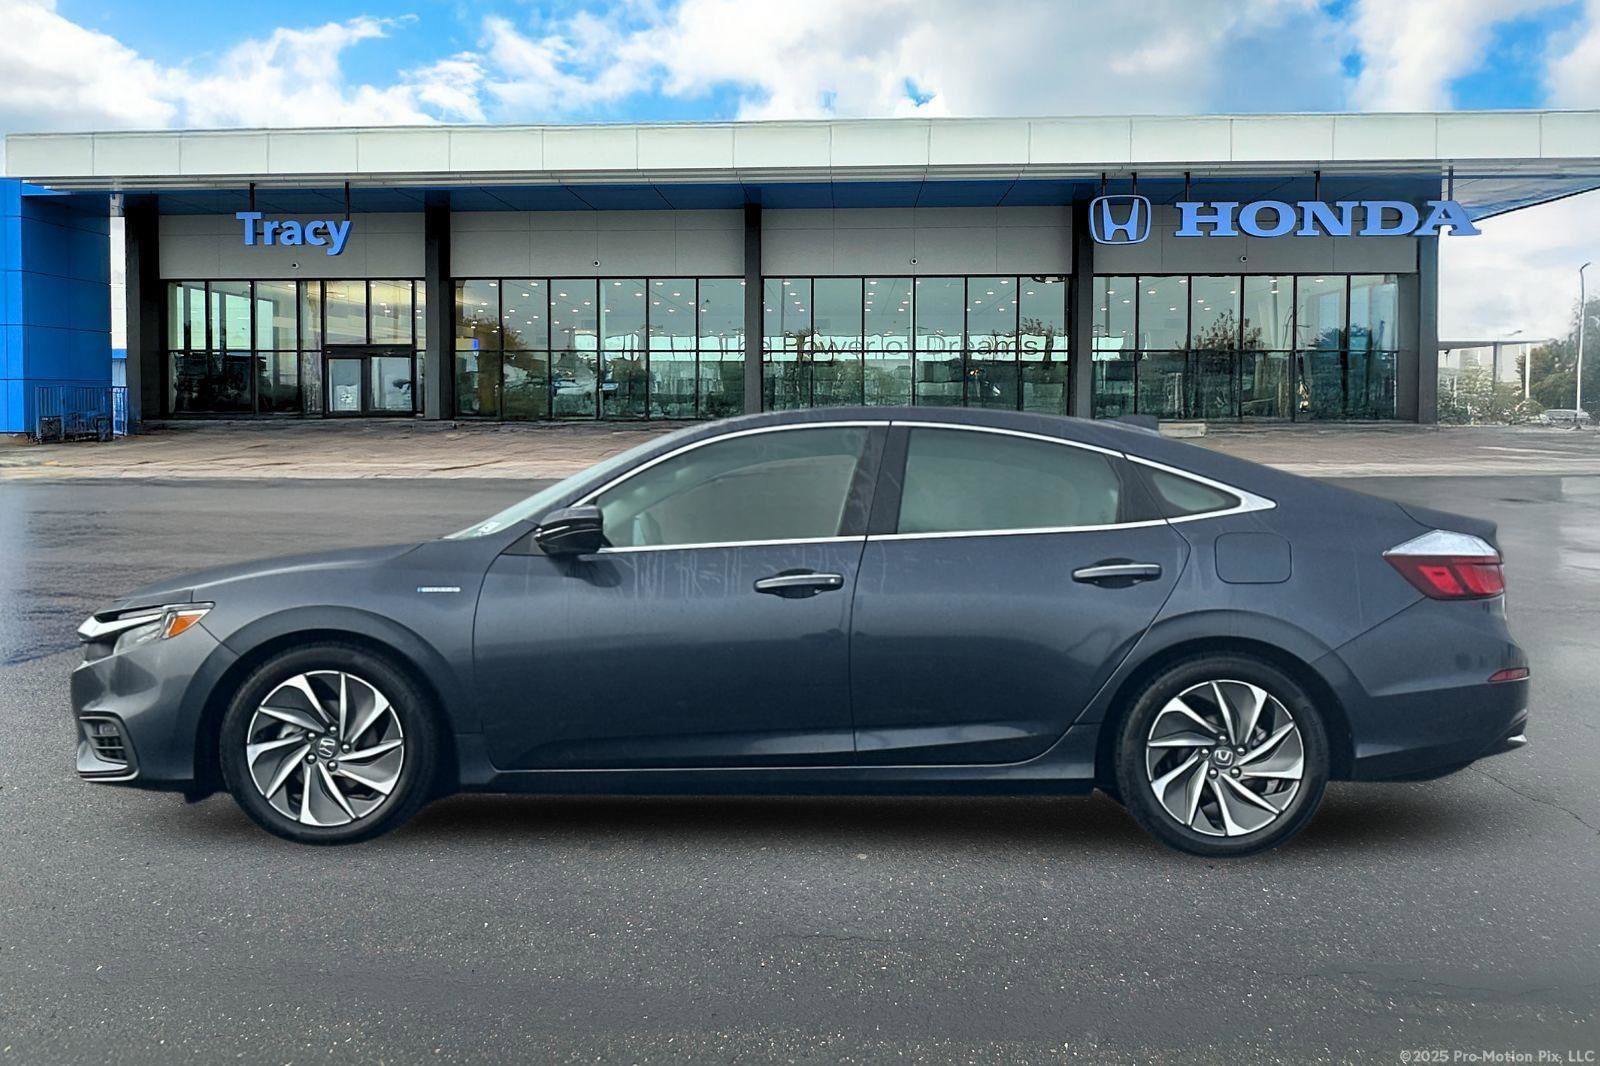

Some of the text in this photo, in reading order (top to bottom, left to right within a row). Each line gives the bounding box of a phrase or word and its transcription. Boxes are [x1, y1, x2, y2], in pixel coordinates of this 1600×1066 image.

[235, 211, 352, 256] Tracy
[1175, 200, 1481, 238] HONDA
[783, 335, 876, 355] Power
[927, 335, 1038, 355] Dreams
